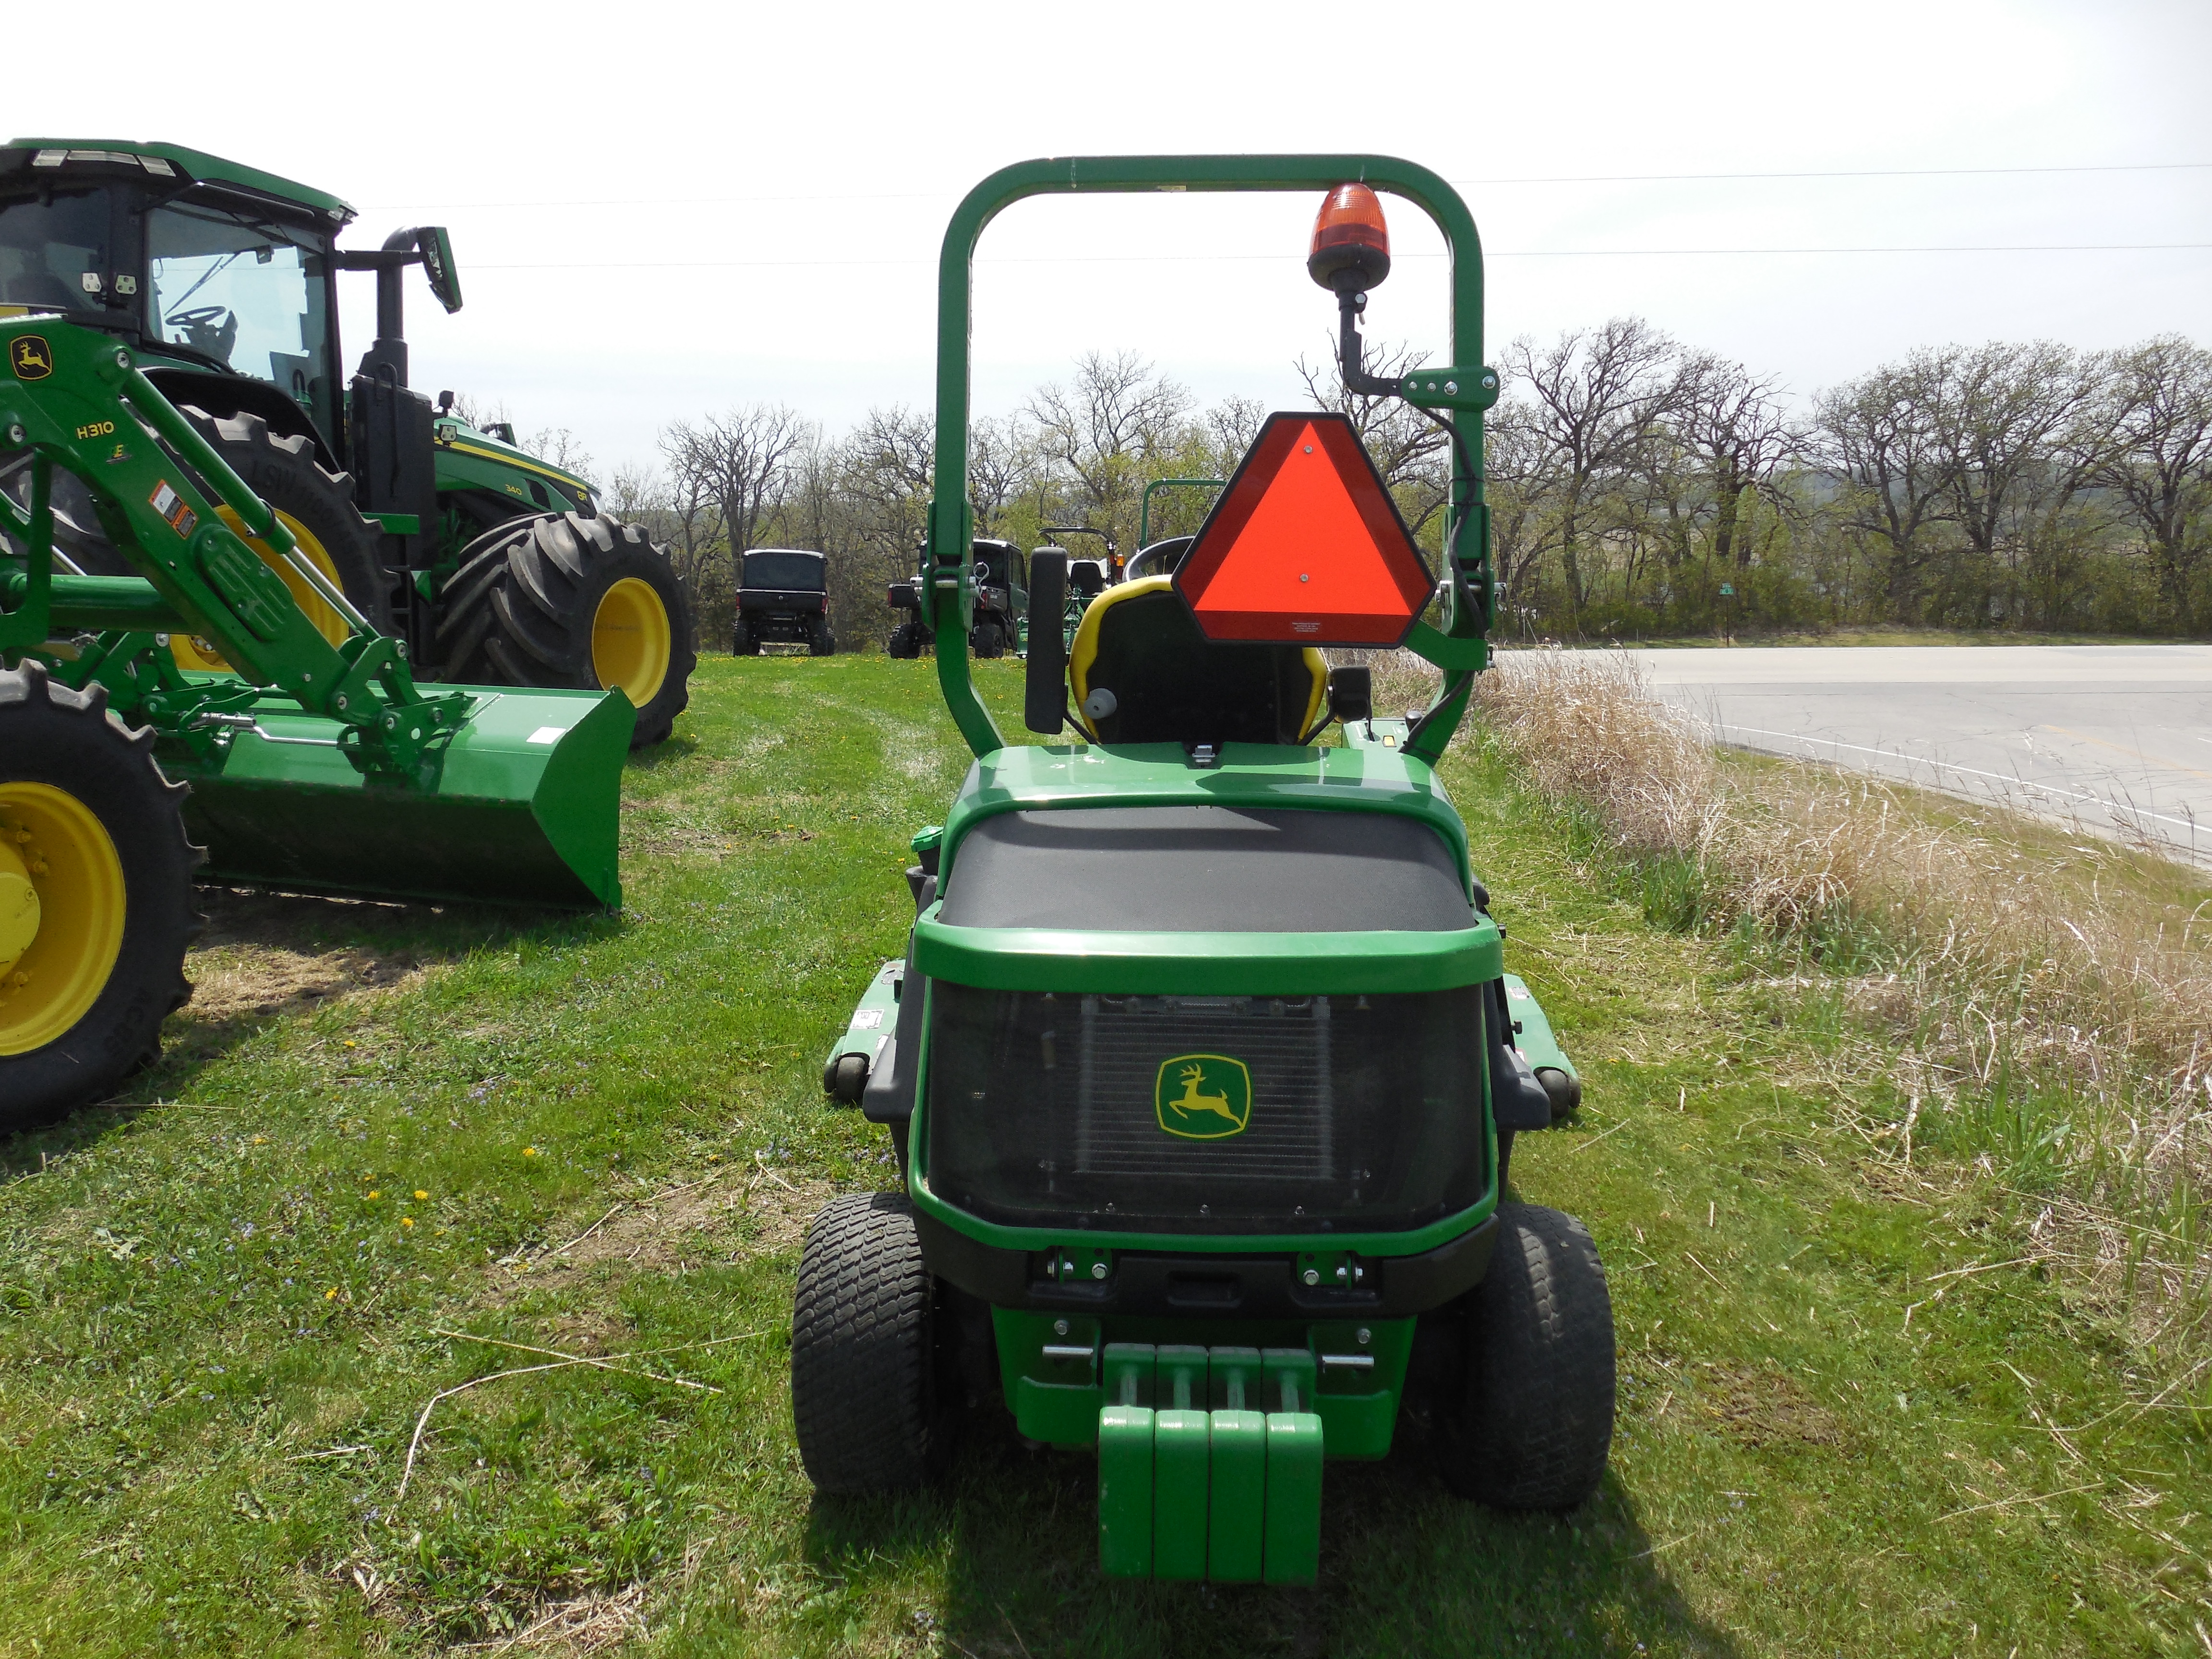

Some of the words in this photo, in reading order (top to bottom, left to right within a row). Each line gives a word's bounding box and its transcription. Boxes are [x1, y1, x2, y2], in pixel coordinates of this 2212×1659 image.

[76, 421, 115, 440] H310
[505, 484, 522, 496] 340
[577, 491, 588, 502] 8R
